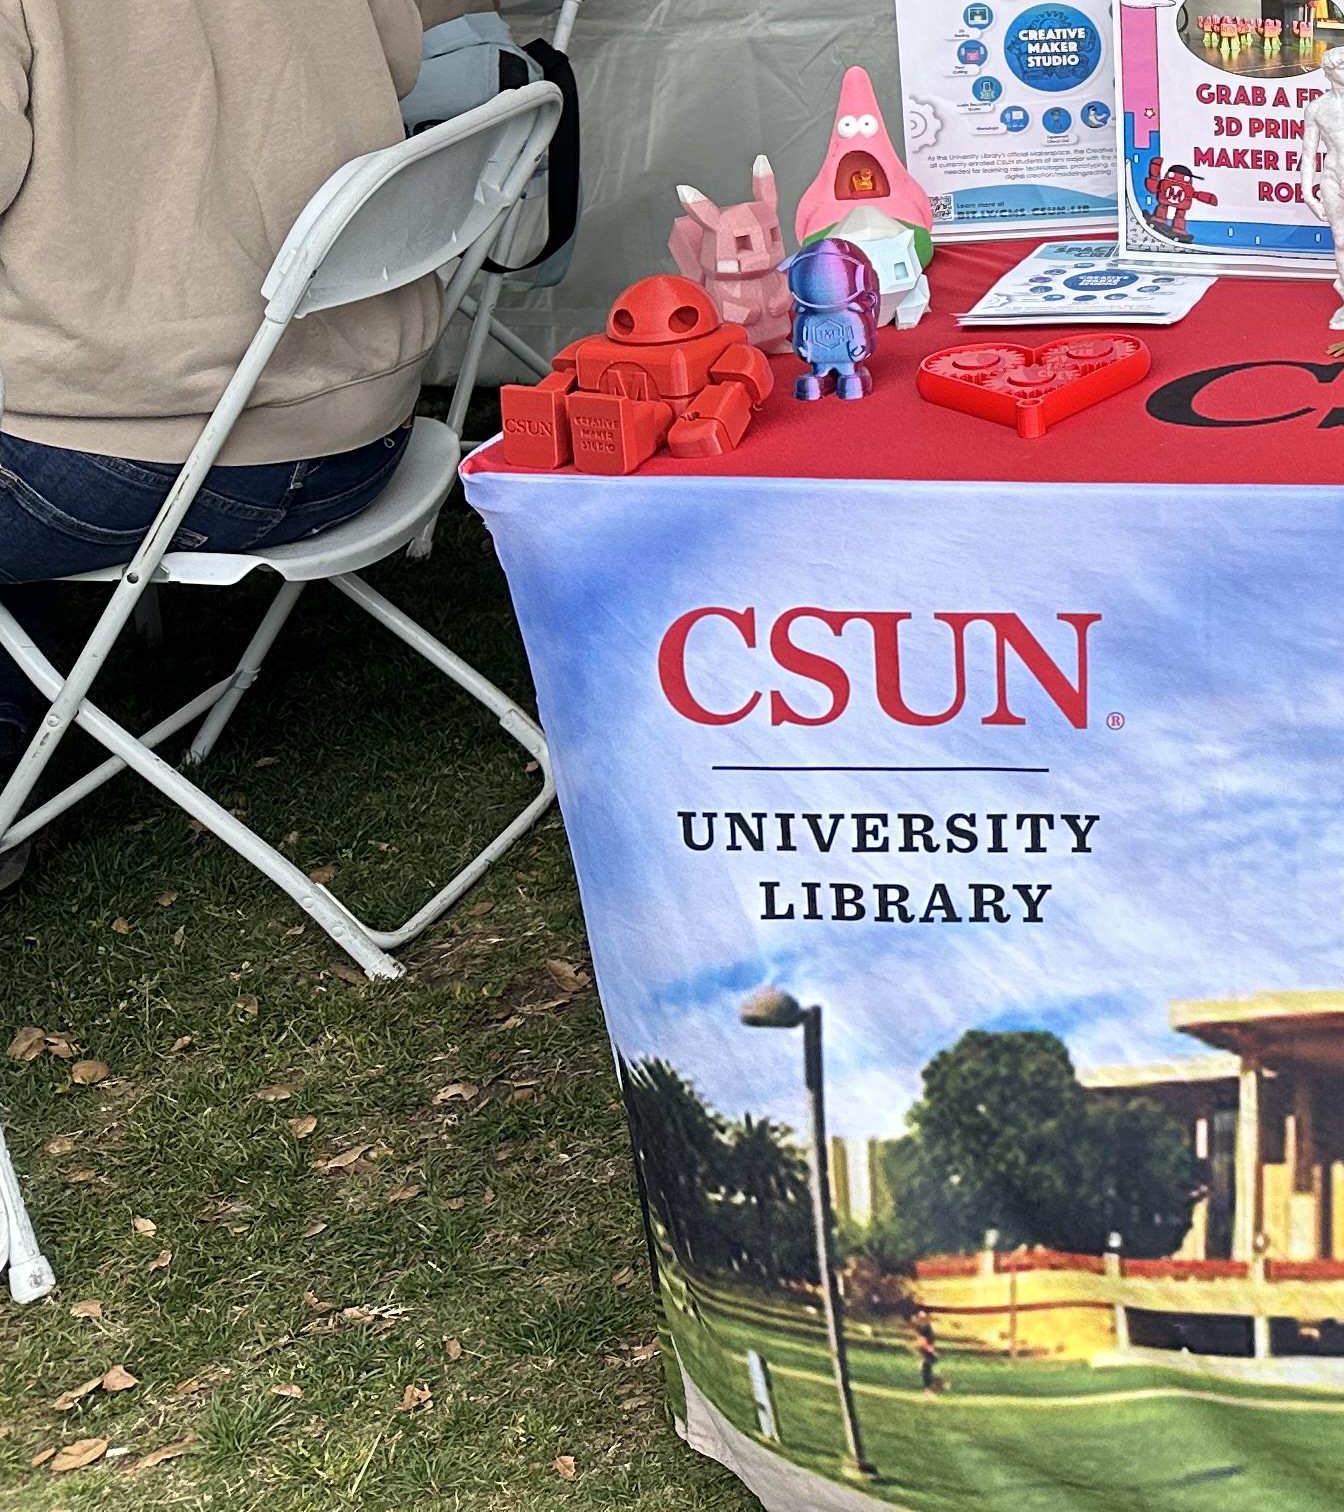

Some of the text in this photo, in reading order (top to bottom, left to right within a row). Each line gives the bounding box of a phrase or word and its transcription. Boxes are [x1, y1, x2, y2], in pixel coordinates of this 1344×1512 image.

[1018, 27, 1086, 41] CREATIVE
[1027, 41, 1078, 54] MAKER
[1027, 54, 1080, 68] STUDIO
[1196, 83, 1291, 108] GRAB A
[1213, 115, 1243, 137] 3D
[949, 152, 979, 161] University
[1085, 146, 1114, 154] Creative
[1015, 157, 1043, 165] students
[1193, 146, 1280, 171] MAKER
[504, 418, 554, 437] CSUN
[580, 442, 616, 453] STUDIO
[657, 606, 1103, 730] CSUN
[677, 811, 1101, 854] UNIVERSITY
[759, 881, 1053, 924] LIBRARY
